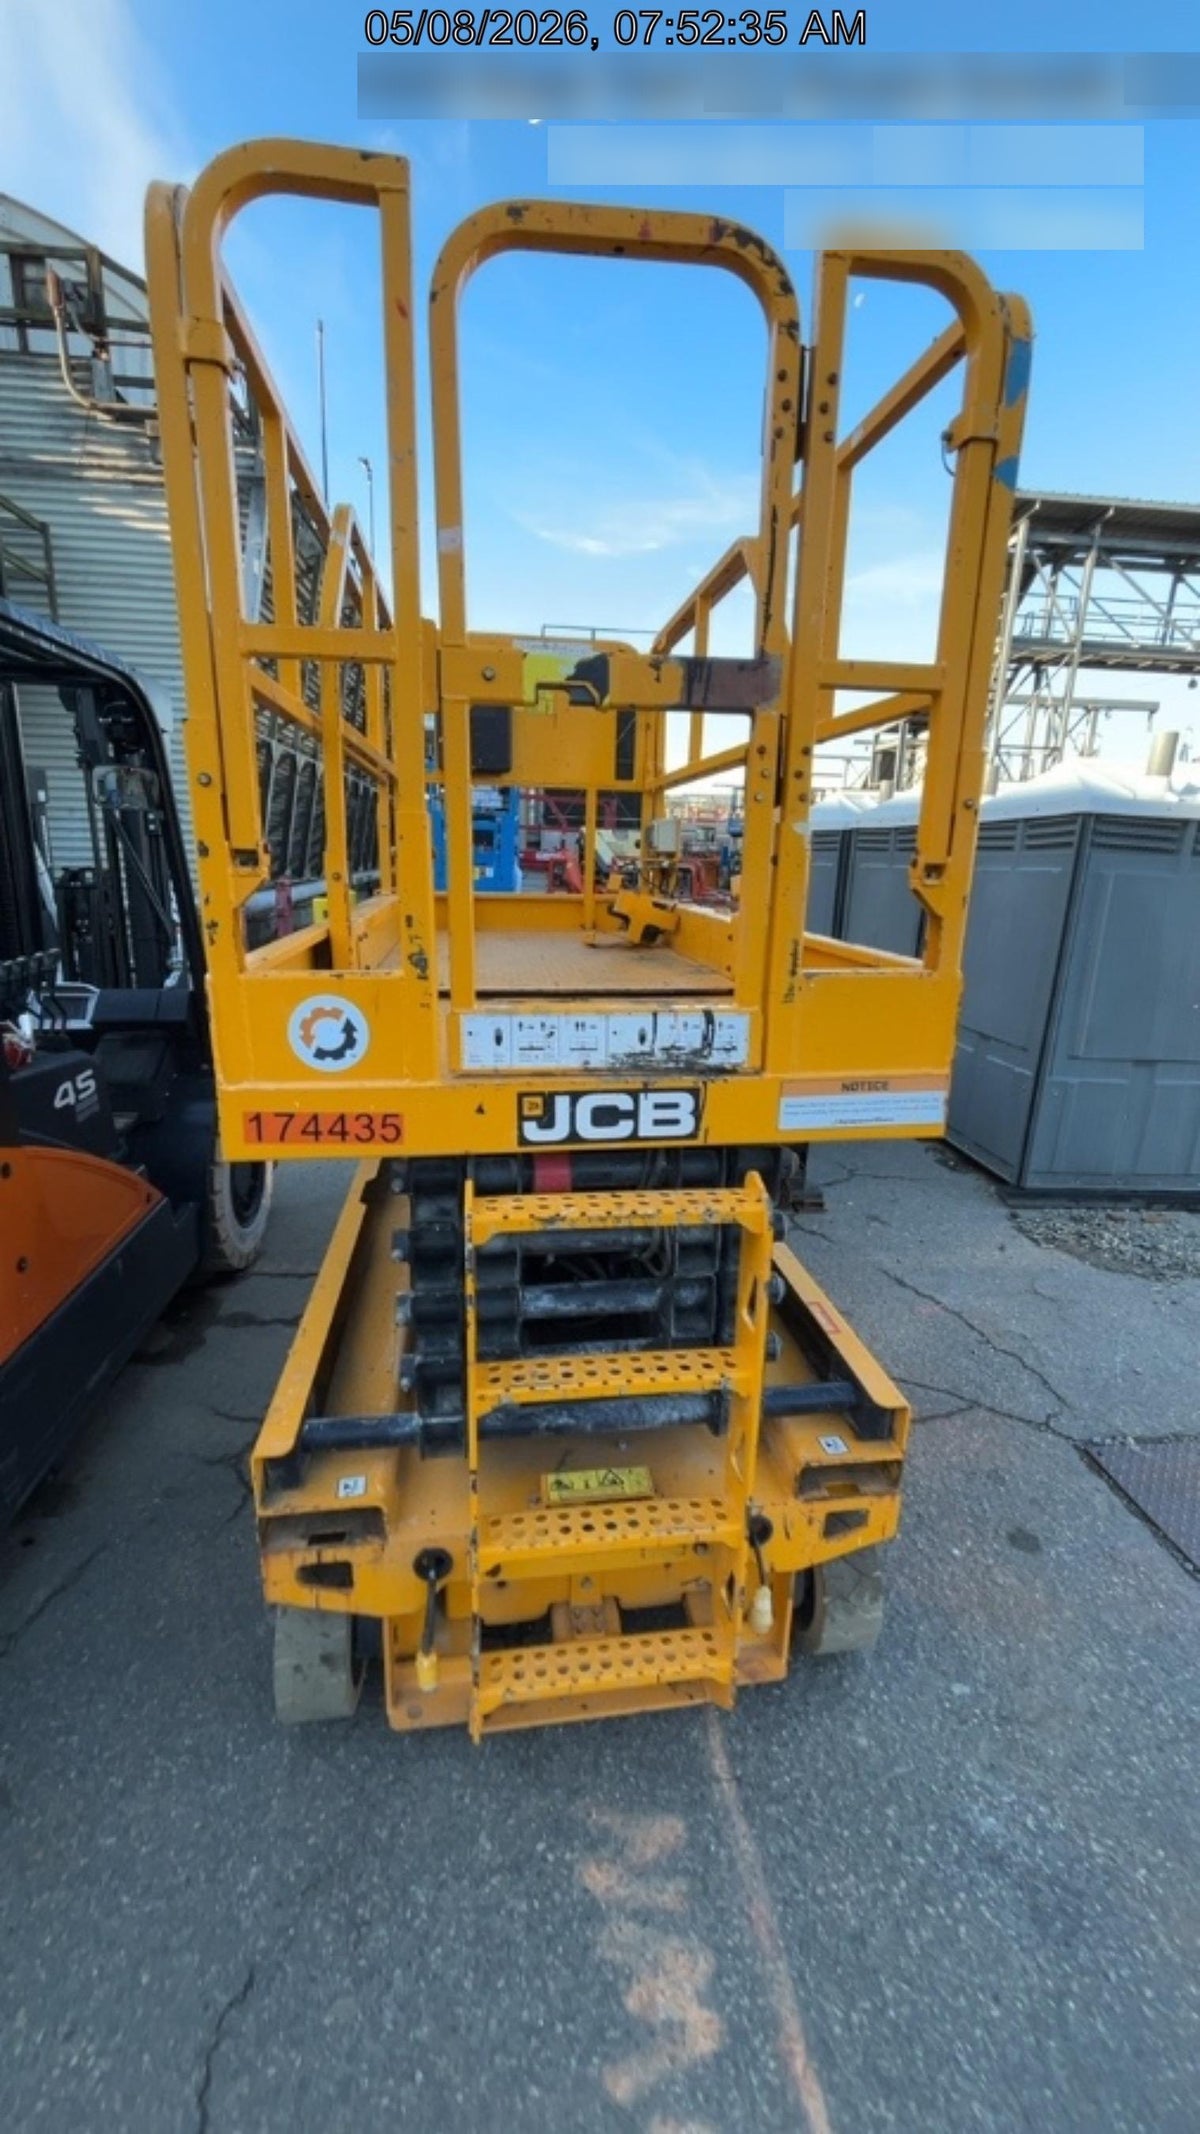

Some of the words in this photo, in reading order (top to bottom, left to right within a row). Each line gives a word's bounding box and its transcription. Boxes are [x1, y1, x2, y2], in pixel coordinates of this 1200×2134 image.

[54, 1069, 97, 1109] 45
[842, 1080, 890, 1092] NOTICE
[248, 1112, 402, 1143] 174435
[522, 1092, 696, 1142] JCB
